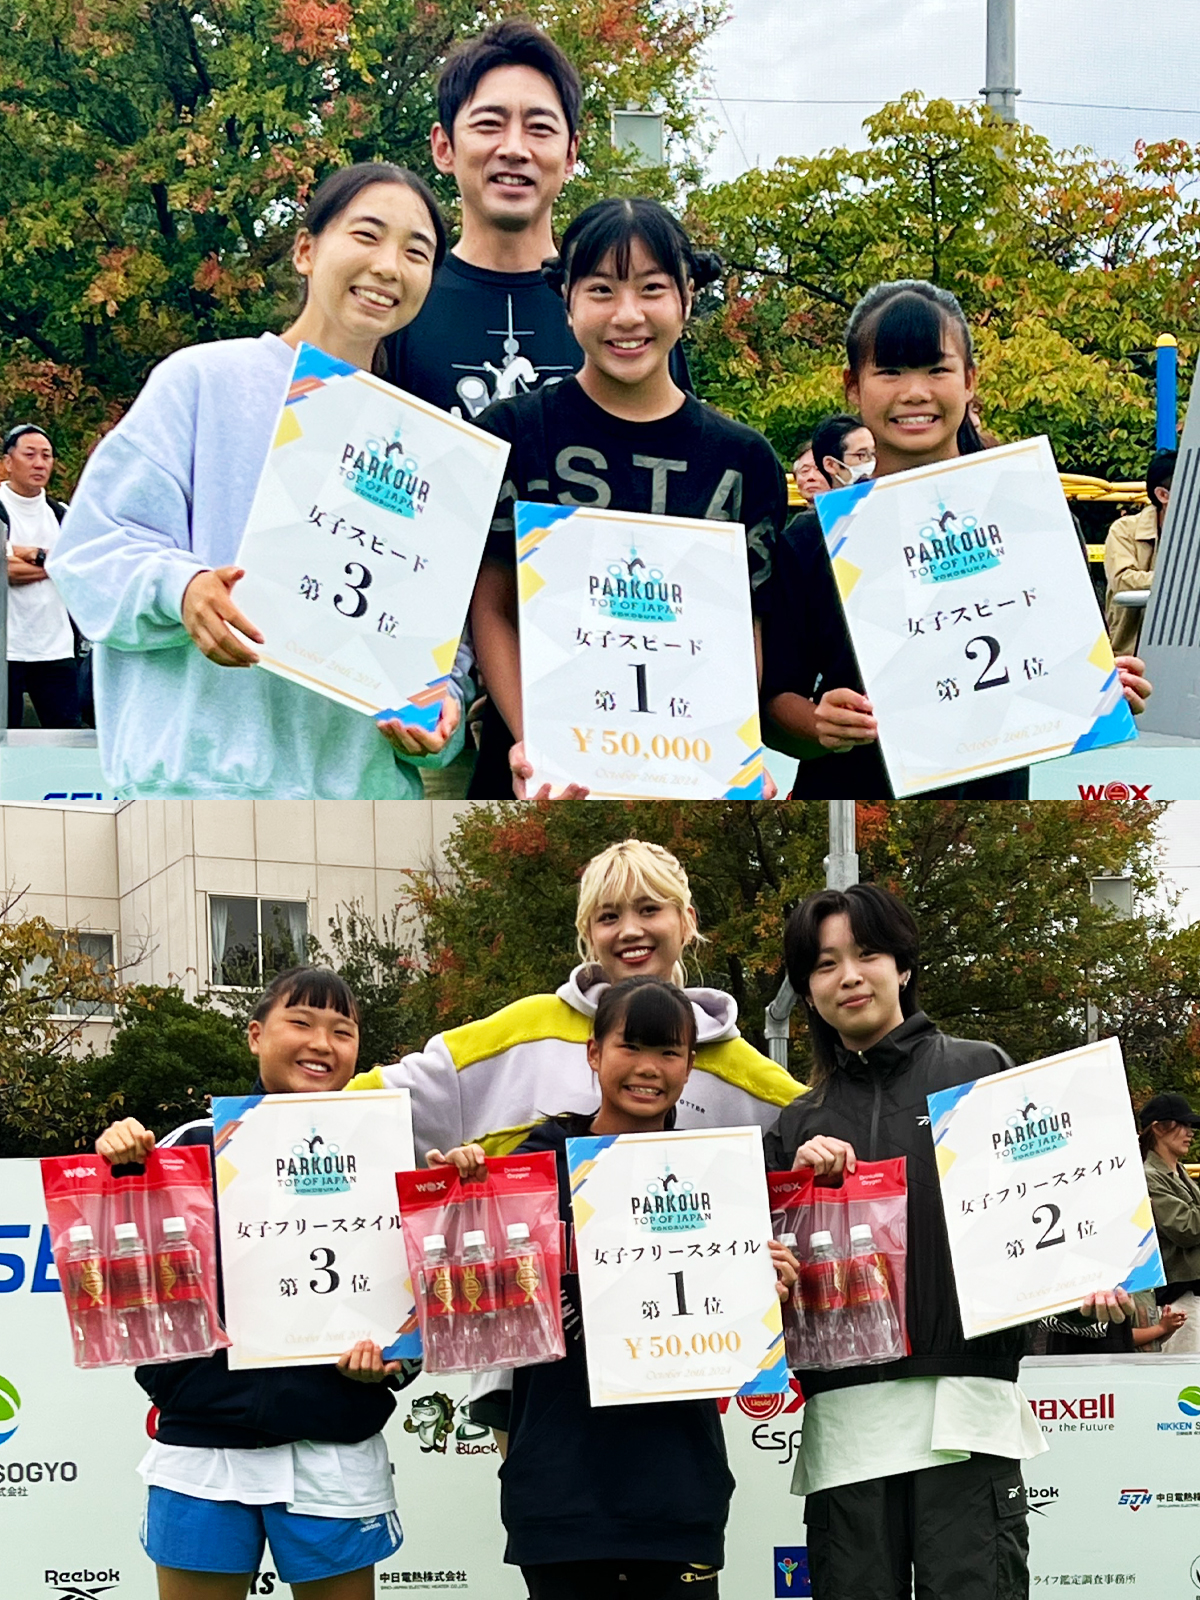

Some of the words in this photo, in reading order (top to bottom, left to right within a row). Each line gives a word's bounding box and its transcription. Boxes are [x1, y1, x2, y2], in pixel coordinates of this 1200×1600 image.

[341, 443, 431, 503] PARKOUR
[339, 466, 364, 484] TOP
[365, 479, 383, 493] OF
[383, 488, 424, 514] JAPAN
[306, 505, 429, 572] 女子スピード
[903, 524, 1003, 567] PARKOUR
[910, 565, 937, 579] TOP
[940, 558, 959, 571] OF
[963, 546, 1006, 568] JAPAN
[589, 575, 683, 604] PARKOUR
[590, 598, 616, 608] TOP
[620, 600, 638, 611] OF
[642, 602, 683, 615] JAPAN
[902, 587, 1036, 639] 女子スピード
[573, 627, 703, 656] 女子スピード
[992, 1112, 1072, 1150] PARKOUR
[994, 1146, 1017, 1160] TOP
[1019, 1142, 1034, 1152] OF
[1036, 1130, 1073, 1148] JAPAN
[63, 1166, 97, 1178] WOX
[276, 1155, 357, 1177] PARKOUR
[277, 1178, 300, 1188] TOP
[303, 1177, 319, 1186] OF
[321, 1175, 357, 1186] JAPAN
[415, 1180, 446, 1192] WOX
[960, 1156, 1127, 1217] 女子フリースタイル
[631, 1192, 711, 1215] PARKOUR
[633, 1215, 655, 1225] TOP
[659, 1214, 675, 1224] OF
[676, 1213, 712, 1222] JAPAN
[592, 1239, 761, 1266] 女子フリースタイル
[1059, 1423, 1077, 1432] the
[1080, 1422, 1115, 1432] Future
[1157, 1421, 1192, 1431] NIKKEN
[455, 1441, 498, 1455] Black
[45, 1568, 120, 1585] Reebok
[379, 1570, 467, 1583] 中日電熱株式会社
